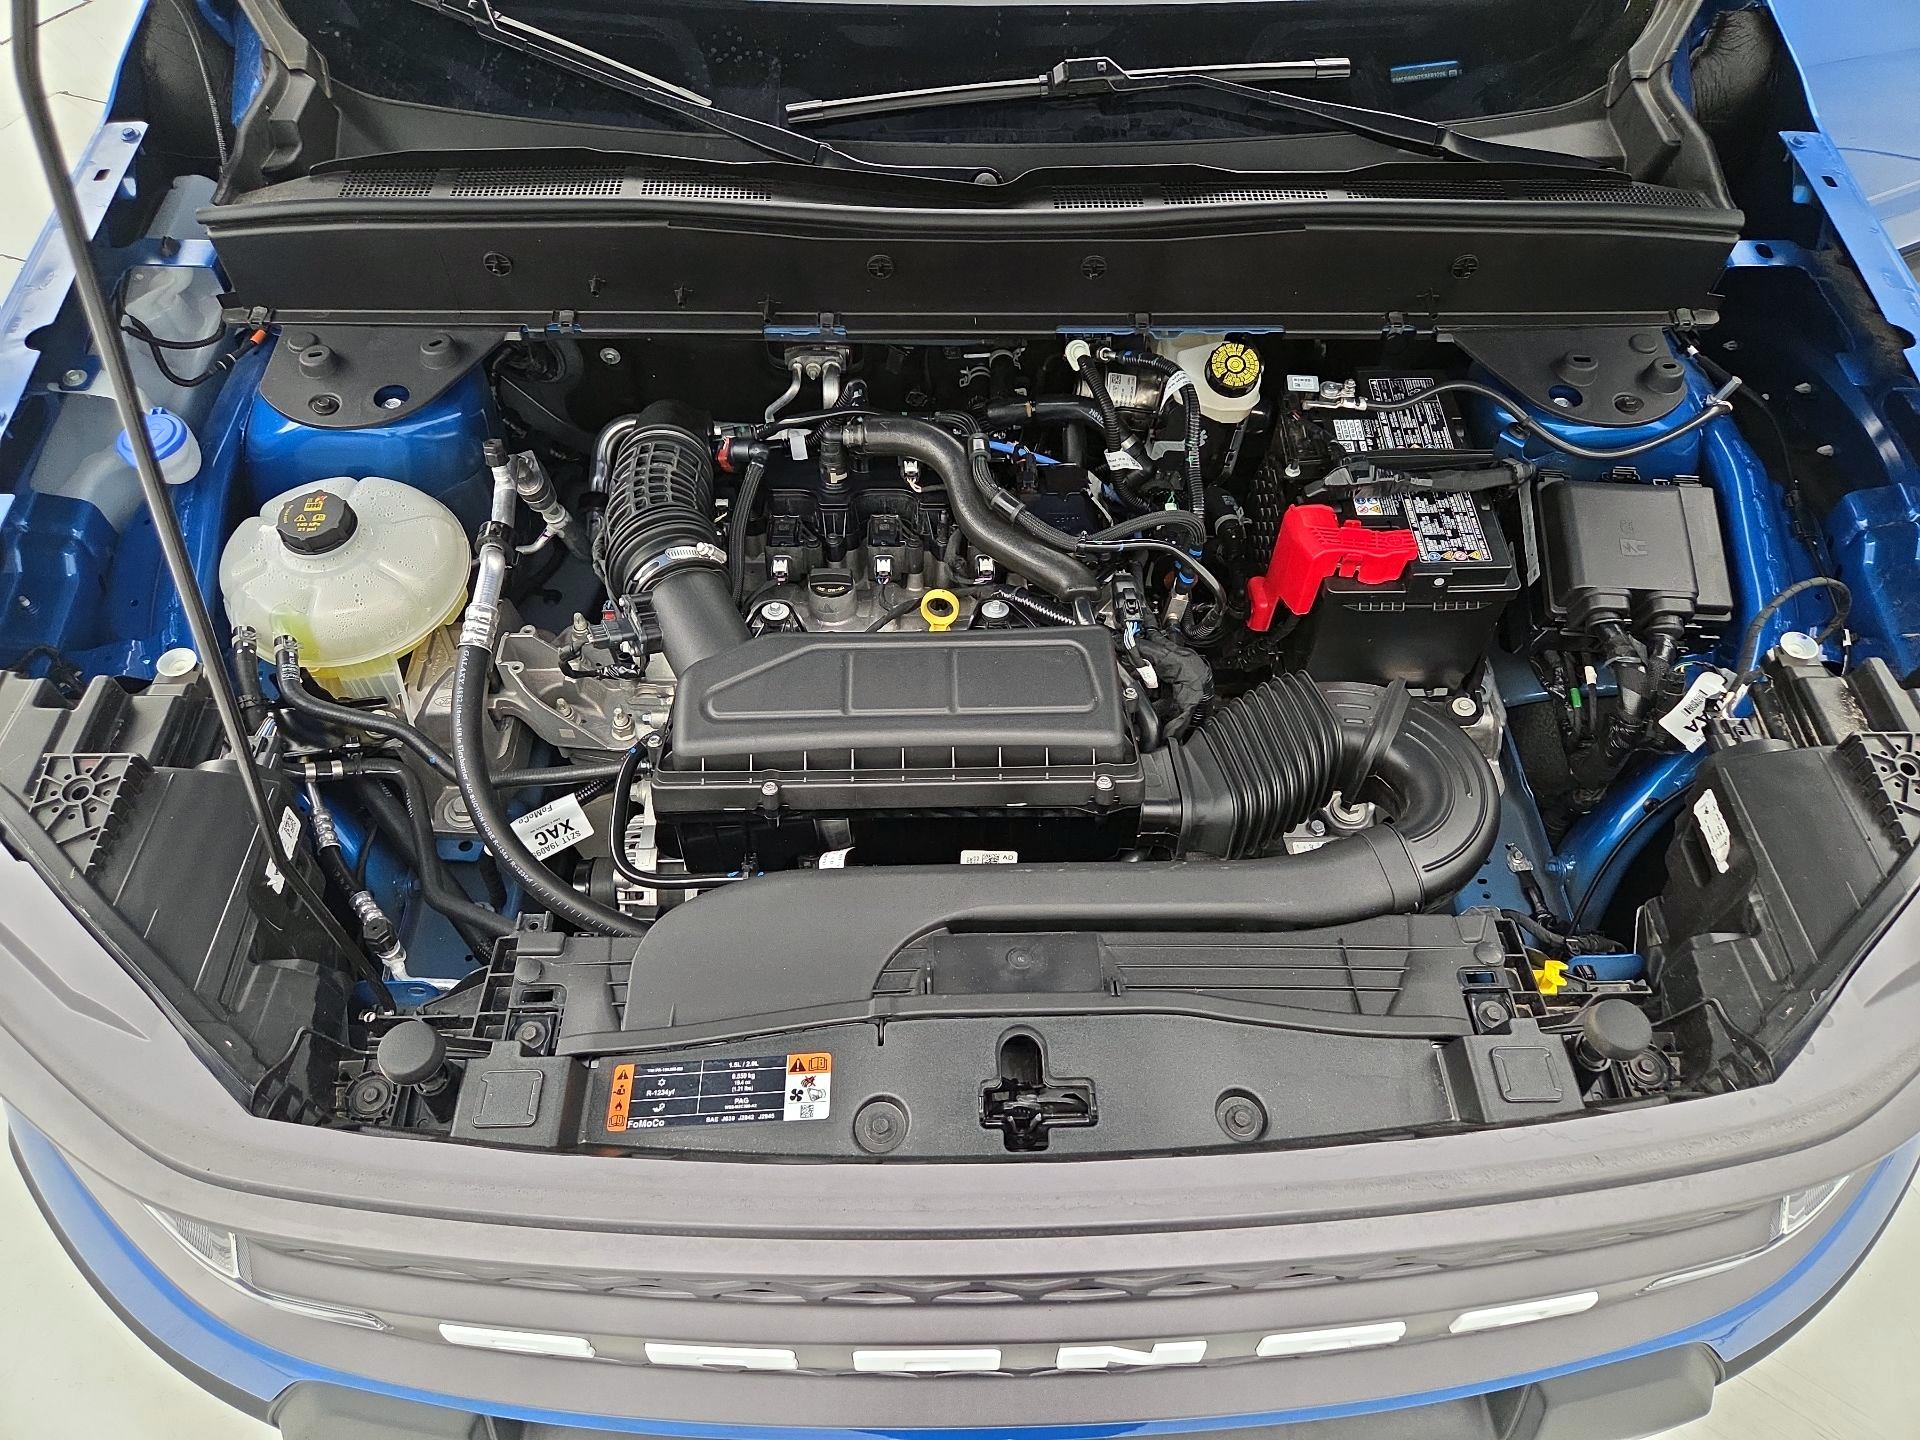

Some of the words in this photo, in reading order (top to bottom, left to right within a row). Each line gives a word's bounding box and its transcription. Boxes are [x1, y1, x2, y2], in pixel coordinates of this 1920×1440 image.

[458, 650, 469, 684] GALAXY
[457, 744, 469, 780] Flexbarrier
[469, 794, 485, 822] SUCTION
[518, 805, 553, 825] FoMoCo
[482, 821, 495, 840] HOSE
[534, 818, 576, 847] XAC
[646, 1088, 676, 1097] R-1234yf
[627, 1118, 665, 1129] FoMoCo
